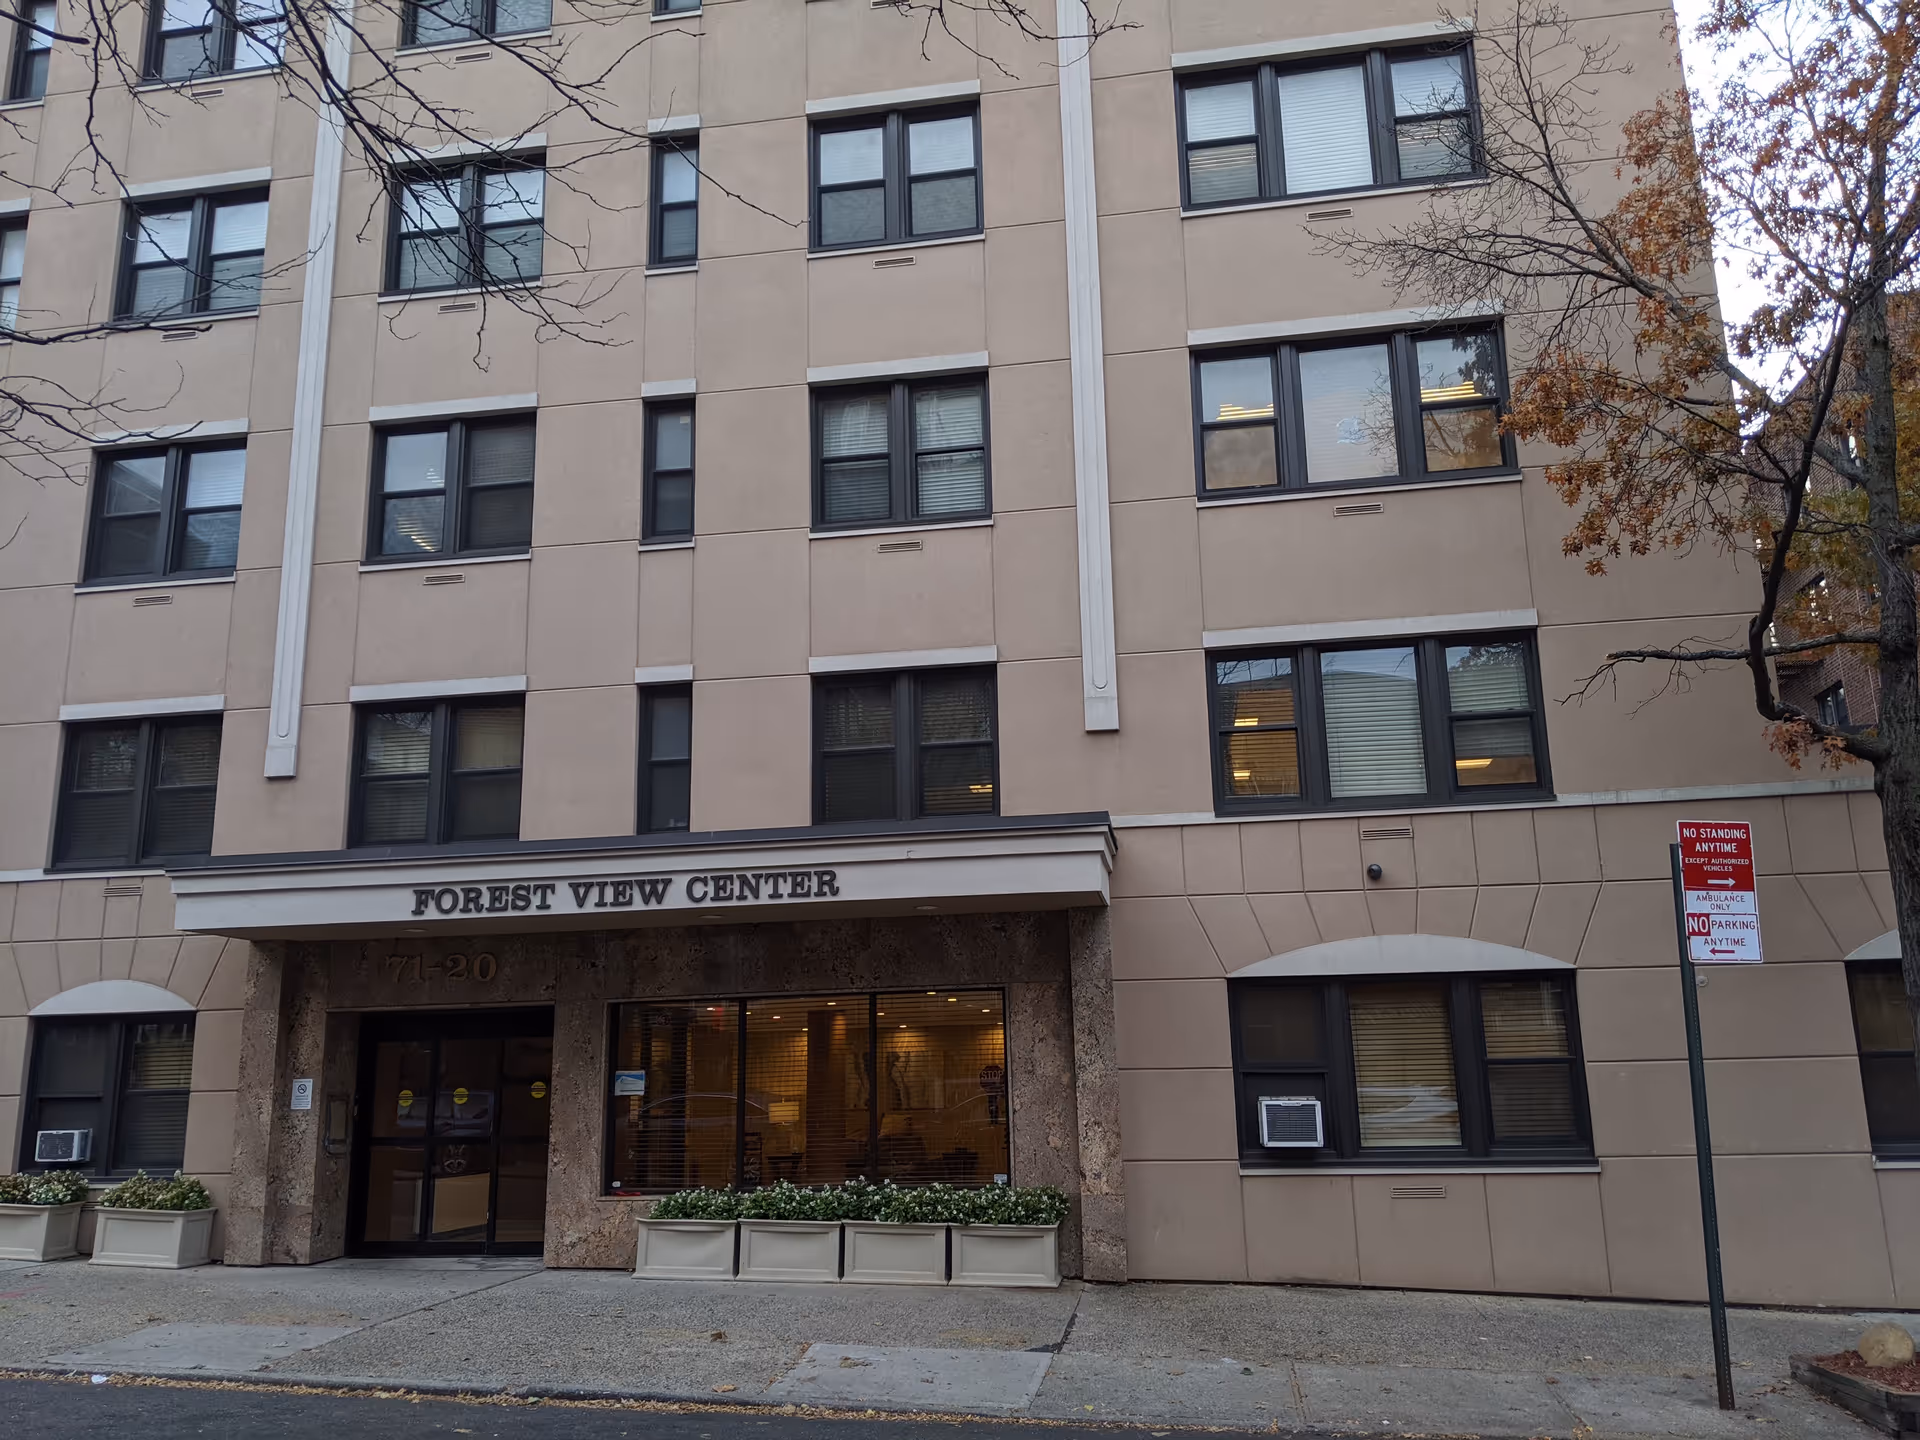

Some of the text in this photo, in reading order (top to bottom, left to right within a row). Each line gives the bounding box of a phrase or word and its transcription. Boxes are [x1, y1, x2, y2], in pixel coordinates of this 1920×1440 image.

[1683, 828, 1747, 839] NO STANDING
[1695, 843, 1738, 853] ANYTIME
[410, 869, 840, 916] FOREST VIEW CENTER
[1696, 894, 1745, 903] AMBULANCE
[1710, 903, 1731, 911] ONLY
[1688, 916, 1756, 933] NO PARKING
[1703, 938, 1747, 947] ANYTIME
[384, 951, 497, 983] 71-20
[981, 1070, 1004, 1080] STOP
